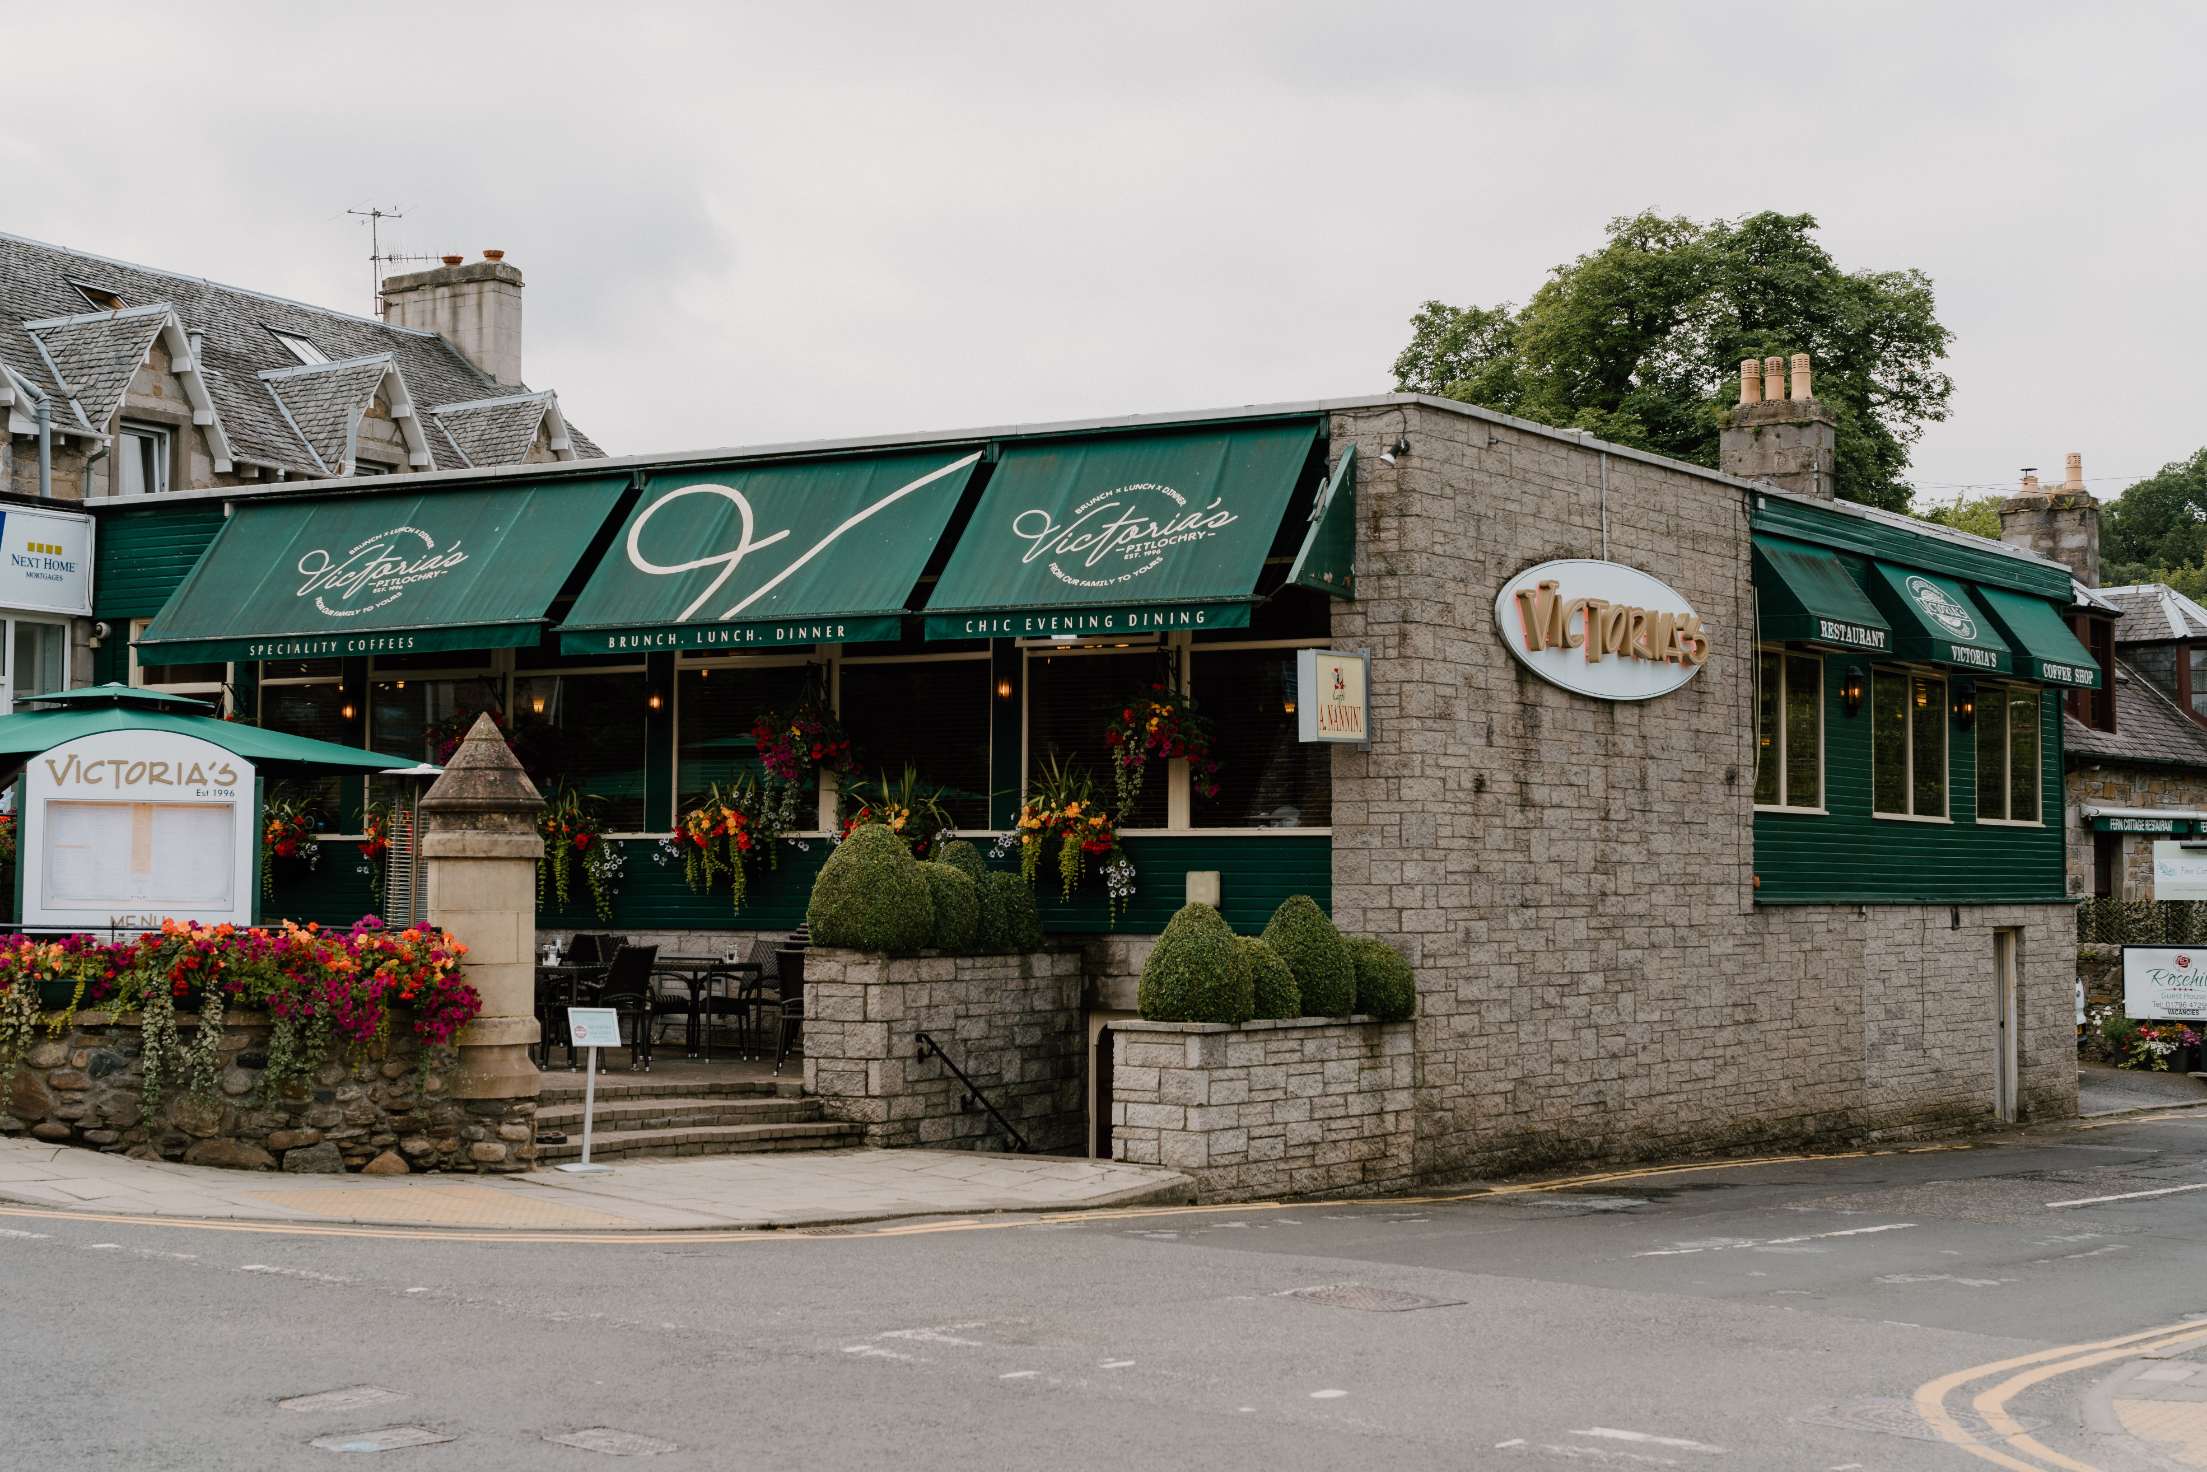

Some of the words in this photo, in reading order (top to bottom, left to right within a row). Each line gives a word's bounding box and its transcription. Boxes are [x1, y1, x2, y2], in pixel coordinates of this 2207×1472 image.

[1075, 490, 1112, 514] BRUNCH
[1124, 484, 1155, 492] LUNCH
[1162, 486, 1186, 507] DINNER
[1012, 497, 1238, 567] Victoria's
[11, 553, 42, 568] NEXT
[44, 558, 76, 572] HOME
[297, 540, 469, 600] Victoria's
[1080, 578, 1115, 587] FAMILY
[1118, 574, 1131, 583] TO
[1133, 556, 1164, 576] YOURS
[26, 572, 64, 582] MORTGAGES
[966, 619, 1011, 633] CHIC
[1026, 615, 1113, 631] EVENING
[1128, 610, 1205, 627] DINING
[1514, 579, 1710, 666] VICTORIA'S
[608, 633, 684, 648] BRUNCH.
[697, 630, 762, 643] LUNCH.
[776, 625, 845, 640] DINNER
[1820, 620, 1884, 648] RESTAURANT
[250, 641, 337, 656] SPECIALITY
[348, 637, 414, 651] COFFEES
[1952, 646, 1997, 668] VICTORIA'S
[2043, 663, 2072, 681] COFFEE
[2074, 668, 2094, 684] SHOP
[45, 754, 238, 790] VICTORIA'S
[196, 788, 210, 797] Est
[213, 789, 236, 797] 1996
[2110, 818, 2124, 830] FERN
[2167, 1008, 2200, 1016] VACANCIES
